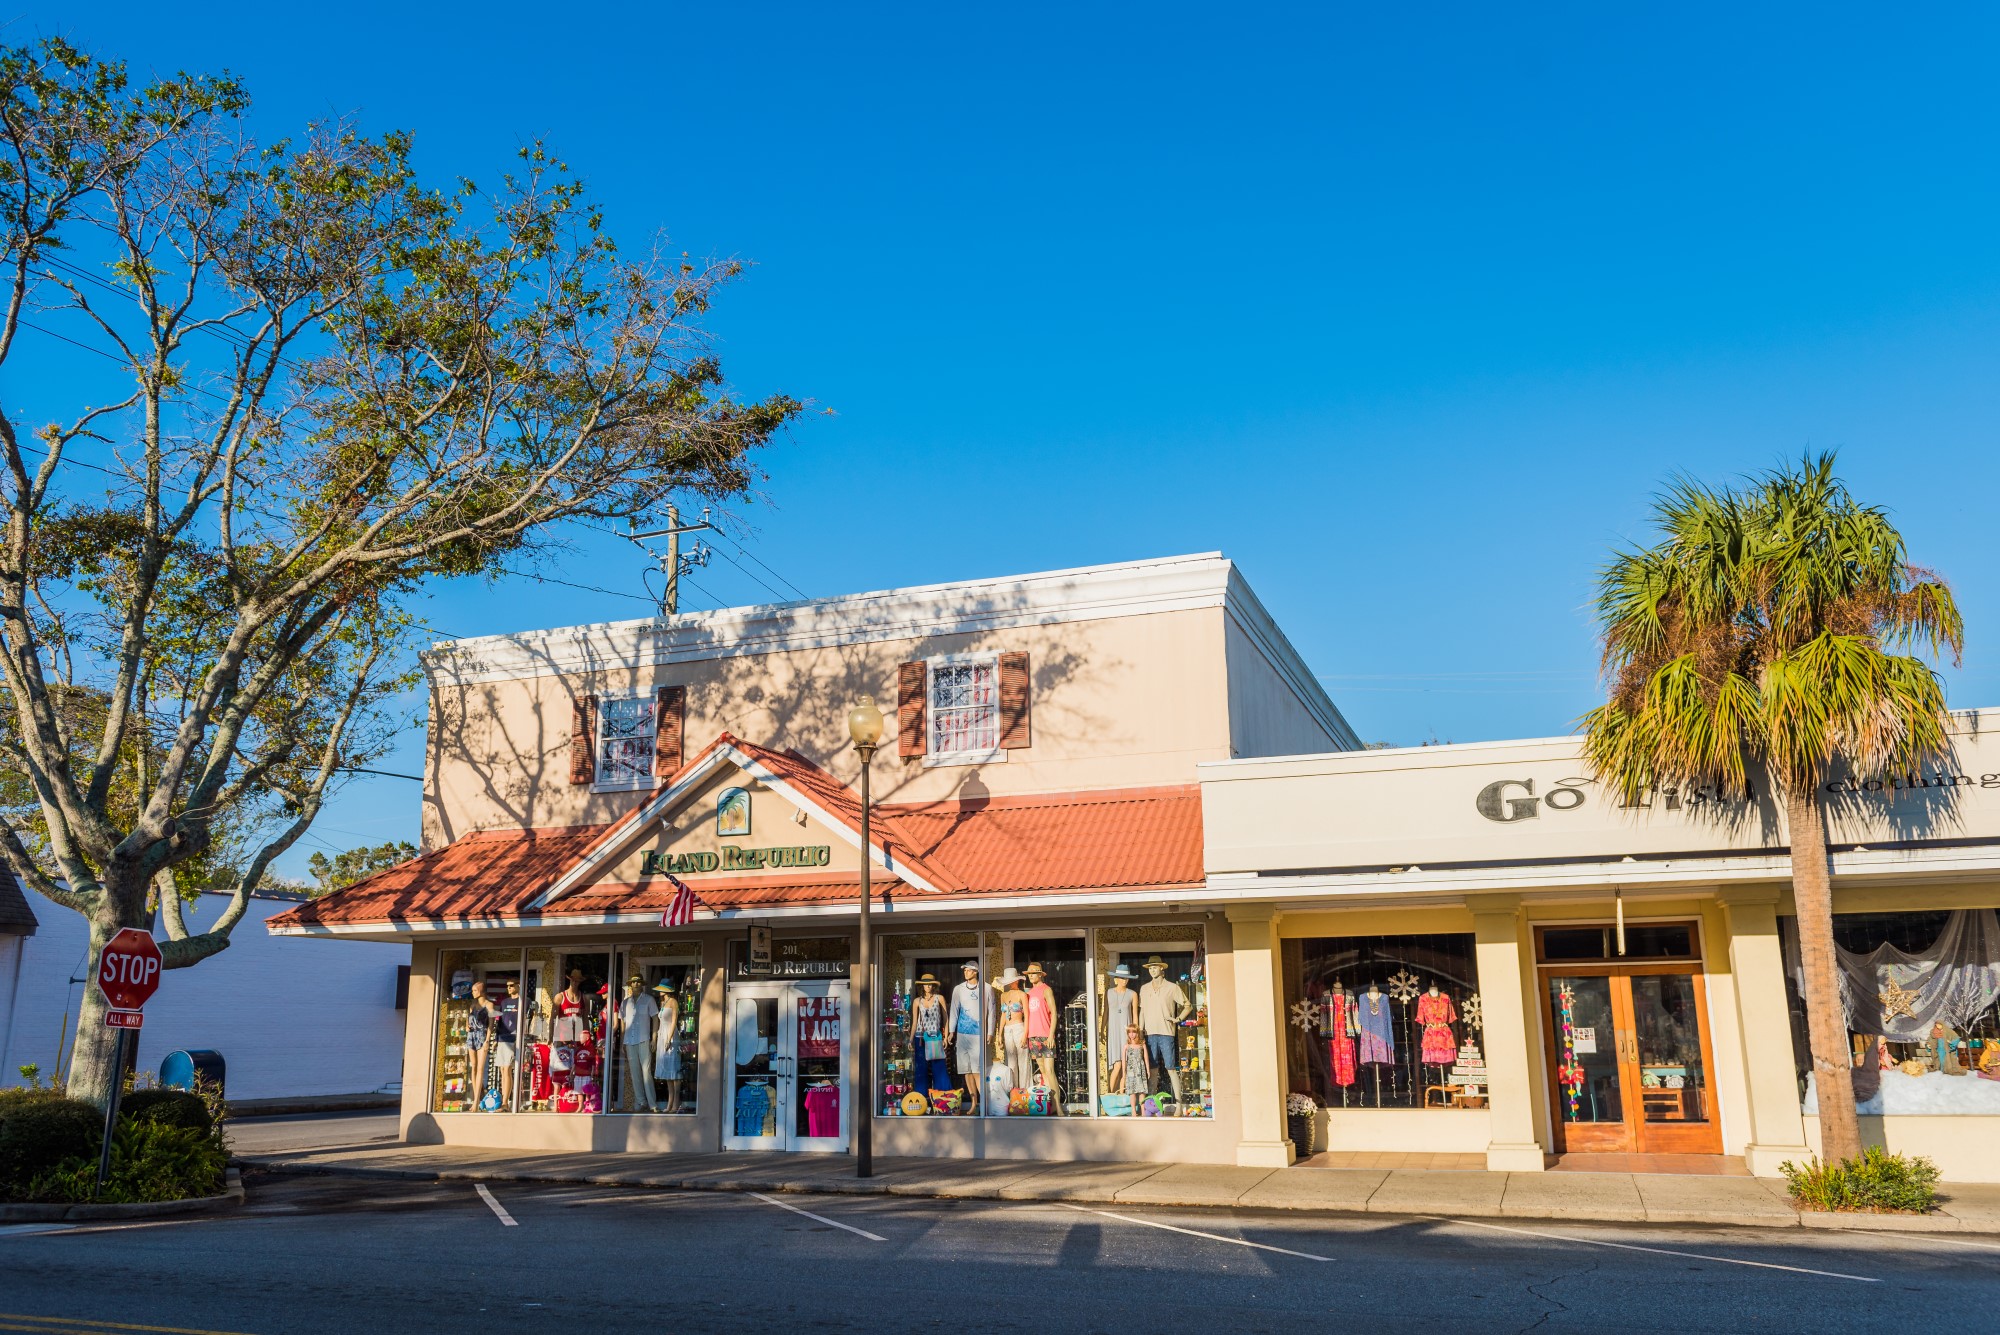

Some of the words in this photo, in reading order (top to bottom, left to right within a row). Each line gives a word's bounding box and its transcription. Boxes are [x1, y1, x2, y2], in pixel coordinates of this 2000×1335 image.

[1476, 777, 1585, 823] Go
[721, 845, 831, 871] REPUBLIC
[783, 945, 798, 955] 201
[103, 952, 158, 985] STOP
[738, 962, 781, 975] ISD
[784, 960, 844, 974] REPUBLIC
[109, 1014, 122, 1025] ALL
[126, 1015, 141, 1026] WAY
[801, 1021, 807, 1040] 1
[811, 1020, 840, 1040] BUY
